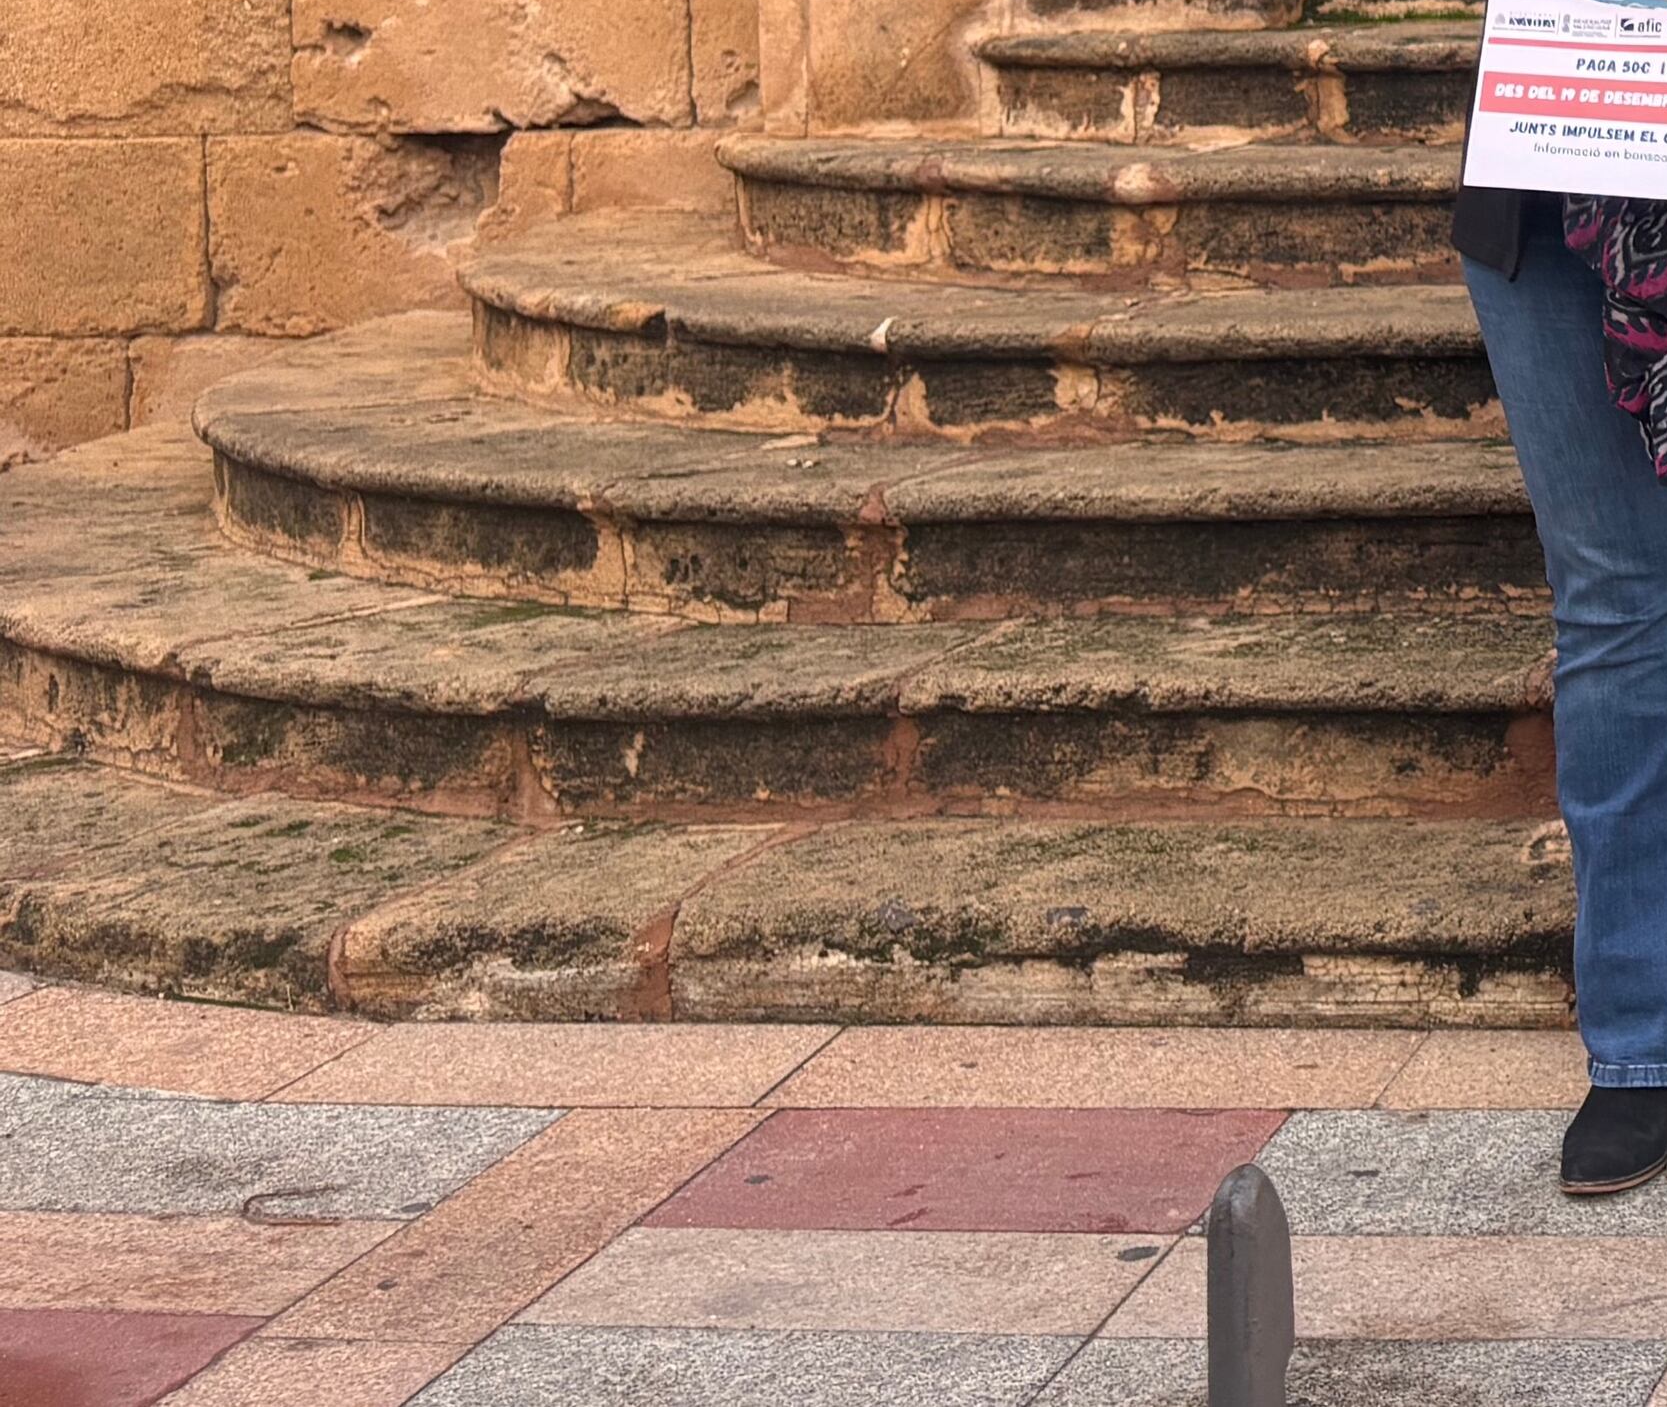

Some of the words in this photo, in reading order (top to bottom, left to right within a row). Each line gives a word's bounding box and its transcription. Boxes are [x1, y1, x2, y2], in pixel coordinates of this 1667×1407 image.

[1638, 18, 1662, 33] afic
[1576, 57, 1616, 73] PAGA
[1494, 83, 1525, 99] DES
[1527, 85, 1557, 101] DEL
[1561, 88, 1576, 103] 19
[1579, 88, 1600, 104] DE
[1509, 120, 1557, 137] JUNTS
[1562, 124, 1635, 142] IMPULSEM
[1640, 130, 1658, 143] EL
